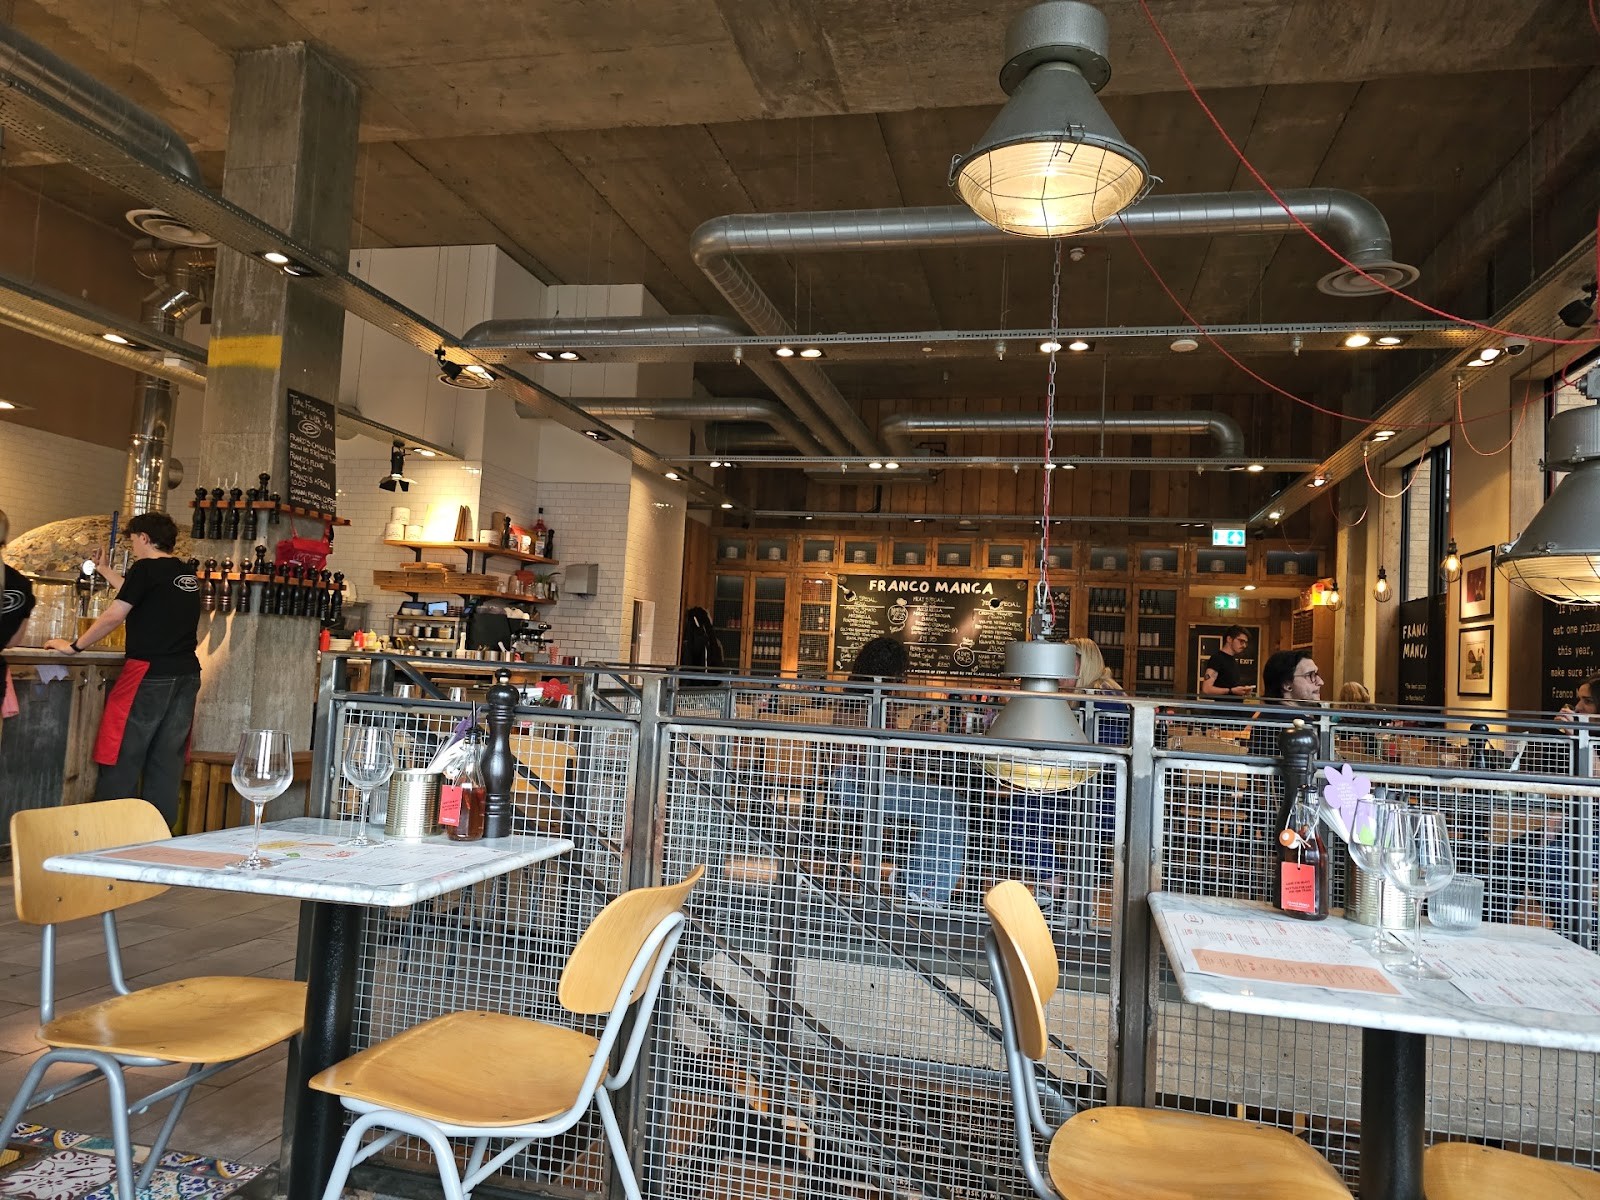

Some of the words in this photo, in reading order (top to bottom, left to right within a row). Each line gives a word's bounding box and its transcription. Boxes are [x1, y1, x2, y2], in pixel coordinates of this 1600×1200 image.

[869, 580, 930, 594] FRANCO
[935, 581, 994, 595] MANCA
[1553, 626, 1564, 635] eat
[1566, 625, 1578, 634] one
[1580, 622, 1600, 636] pizza
[1558, 645, 1572, 656] this
[1575, 646, 1594, 658] year,
[1551, 666, 1565, 677] make
[1568, 668, 1583, 677] sure
[1552, 687, 1574, 699] Franco
